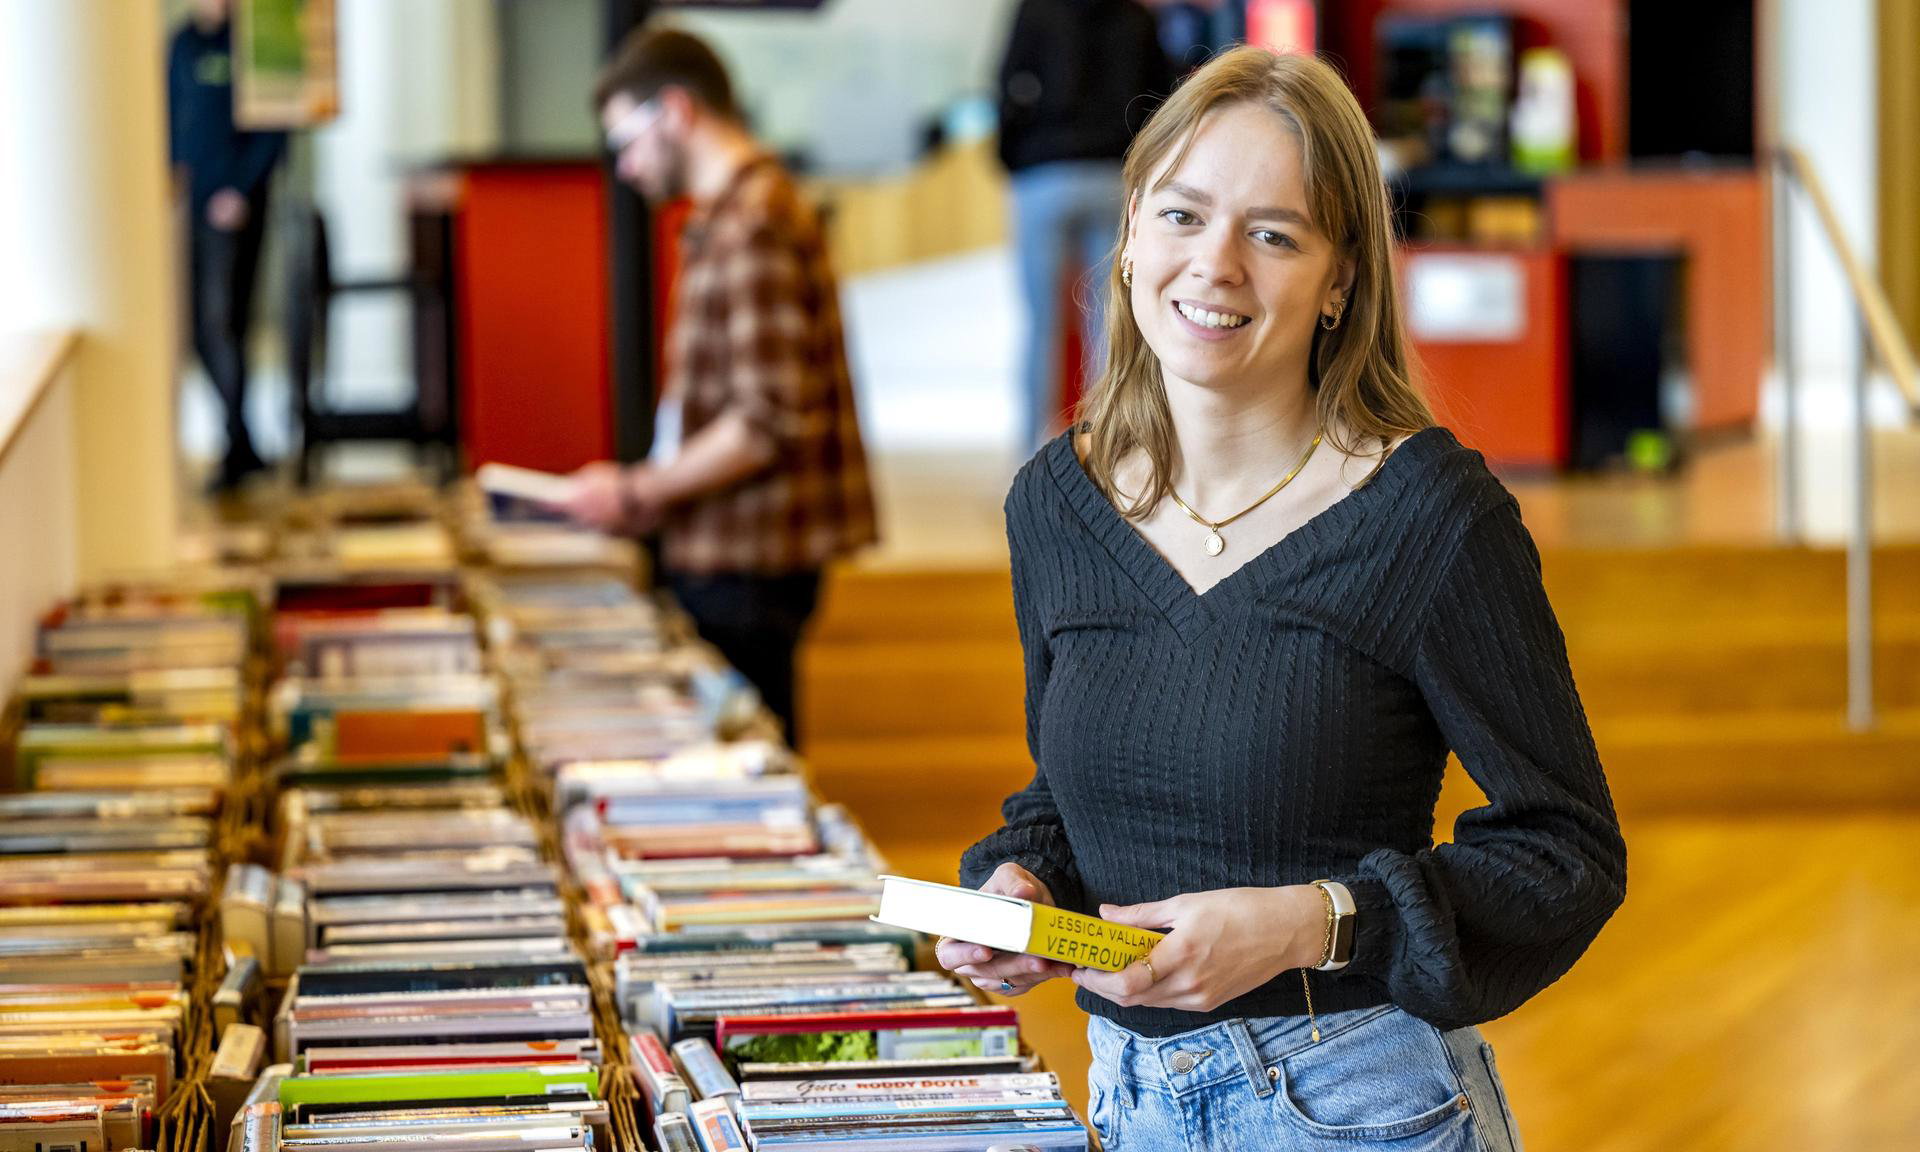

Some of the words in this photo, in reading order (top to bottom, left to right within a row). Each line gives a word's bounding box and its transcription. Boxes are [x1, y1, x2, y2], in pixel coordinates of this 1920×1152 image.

[1049, 913, 1103, 937] JESSICA
[1047, 936, 1137, 968] VERTROUW
[856, 1081, 916, 1089] RODDY
[921, 1079, 979, 1088] DOYLE
[780, 1117, 824, 1125] John
[828, 1114, 896, 1122] Connolly
